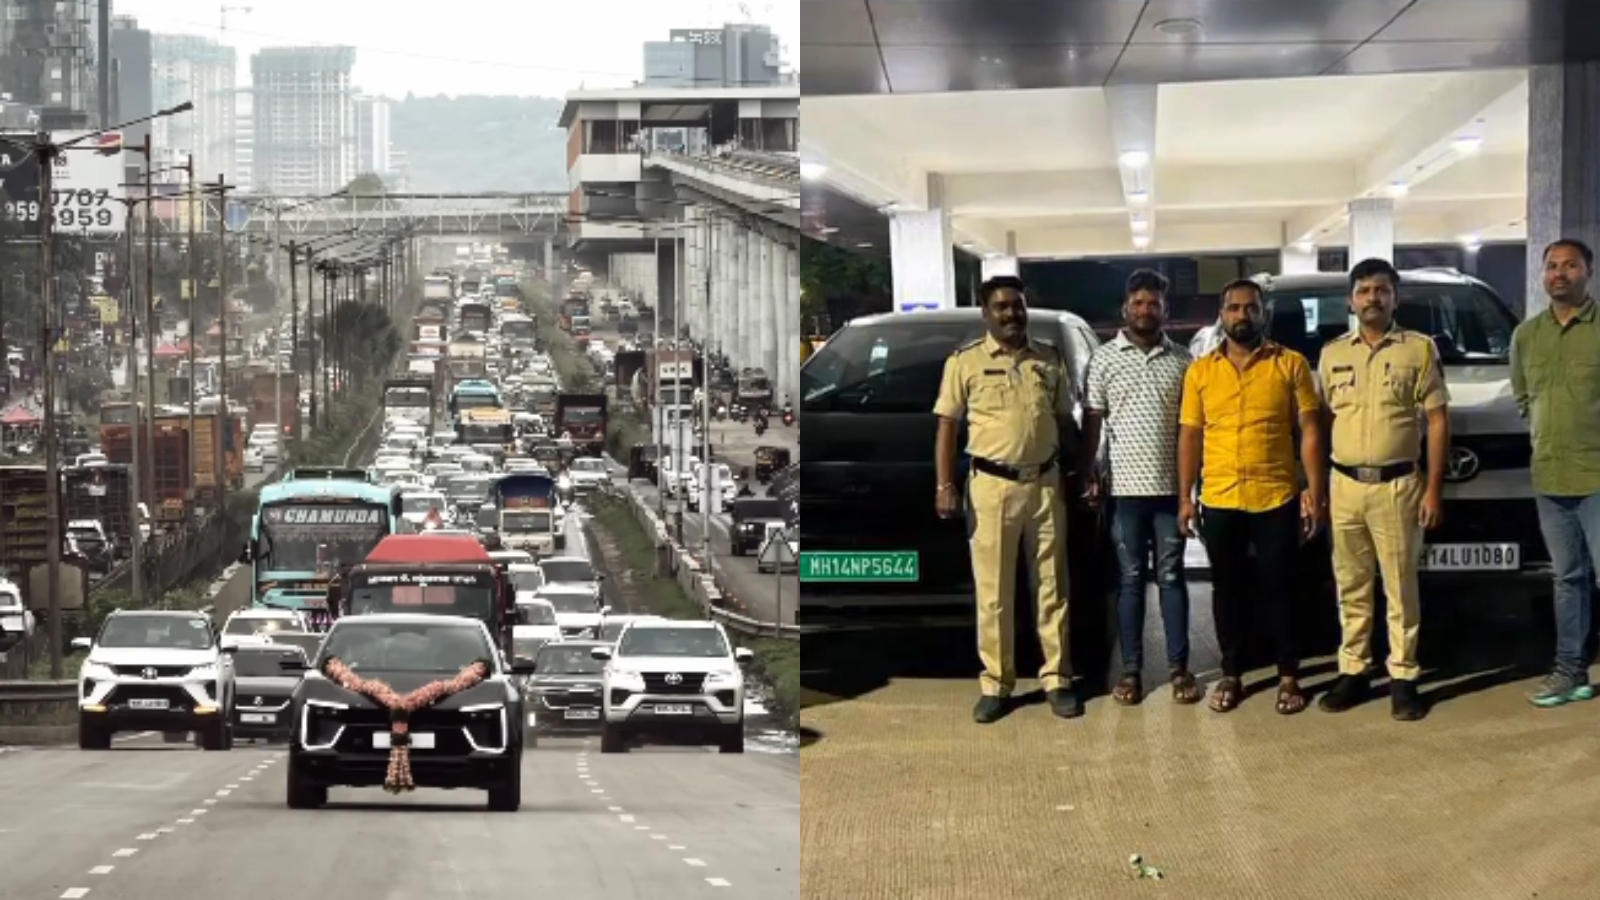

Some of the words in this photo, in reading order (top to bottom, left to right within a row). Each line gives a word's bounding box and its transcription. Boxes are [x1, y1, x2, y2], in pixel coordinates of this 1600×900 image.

[51, 208, 112, 226] 959
[284, 509, 379, 523] CHAMUNDA
[810, 557, 914, 576] MH14NP5644
